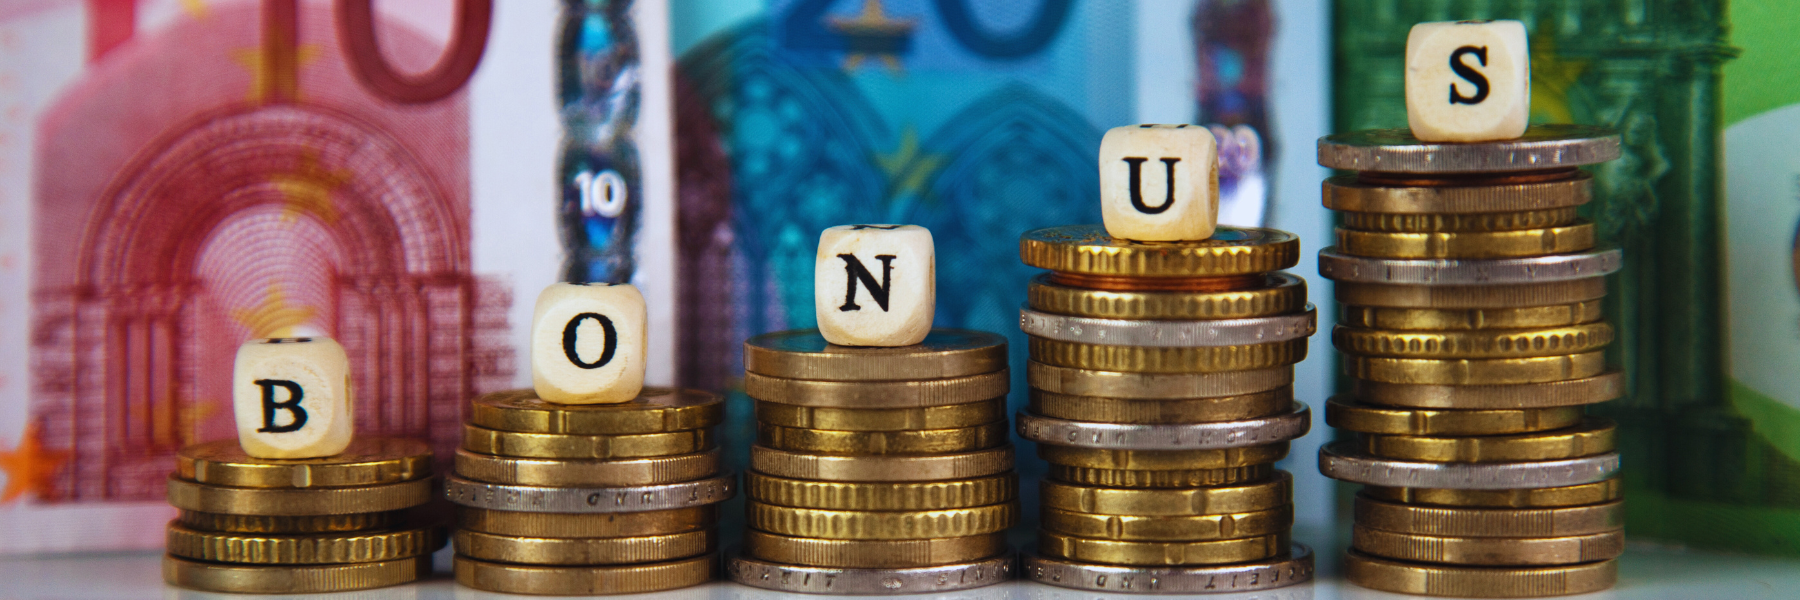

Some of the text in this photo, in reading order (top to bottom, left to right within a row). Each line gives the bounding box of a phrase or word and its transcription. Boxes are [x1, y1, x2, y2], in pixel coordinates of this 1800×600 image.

[1449, 46, 1489, 105] S
[575, 169, 627, 218] 10
[1123, 157, 1180, 214] U
[837, 253, 896, 312] N
[563, 313, 617, 369] O
[254, 379, 308, 433] B
[586, 491, 653, 507] UND
